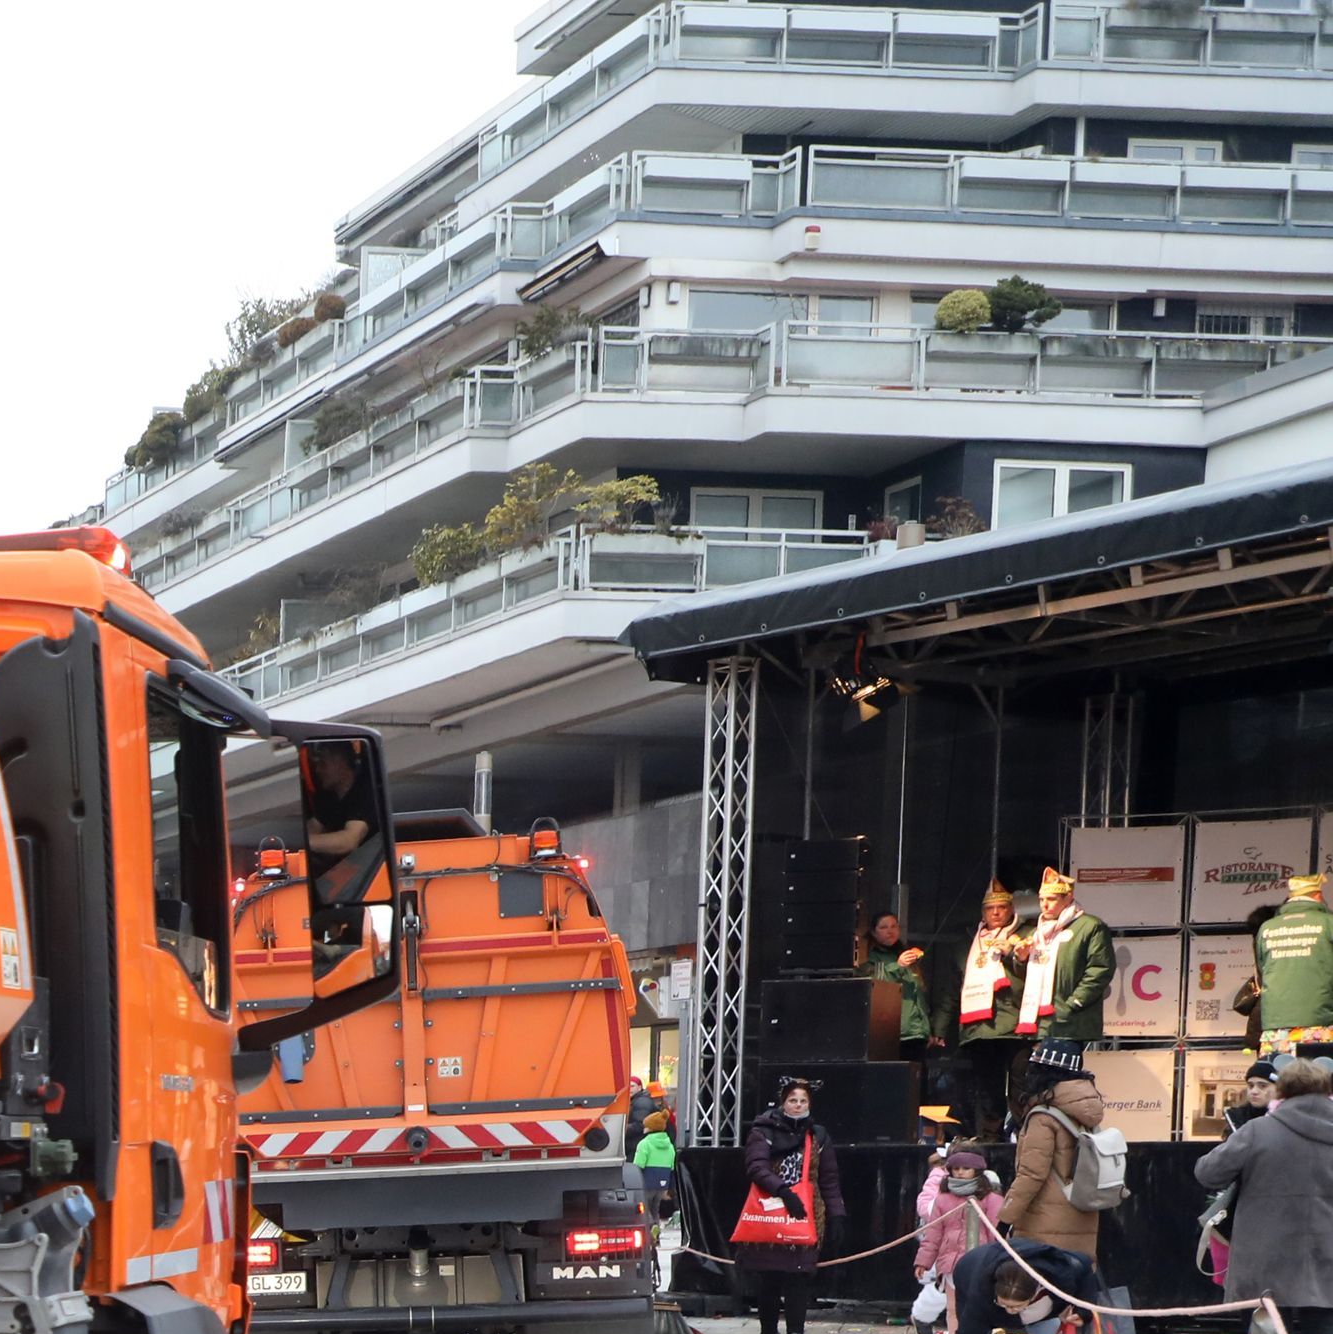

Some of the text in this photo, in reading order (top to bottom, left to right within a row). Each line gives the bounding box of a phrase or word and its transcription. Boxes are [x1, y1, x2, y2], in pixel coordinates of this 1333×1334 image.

[1204, 862, 1294, 883] RISTORANTE
[1262, 924, 1323, 938] Festkomitee
[1265, 937, 1317, 949] Bensberger
[1271, 946, 1311, 959] Karneval
[1137, 1100, 1162, 1109] Bank
[742, 1212, 785, 1224] Zusammen
[552, 1264, 621, 1280] MAN
[251, 1275, 302, 1291] GL 399
